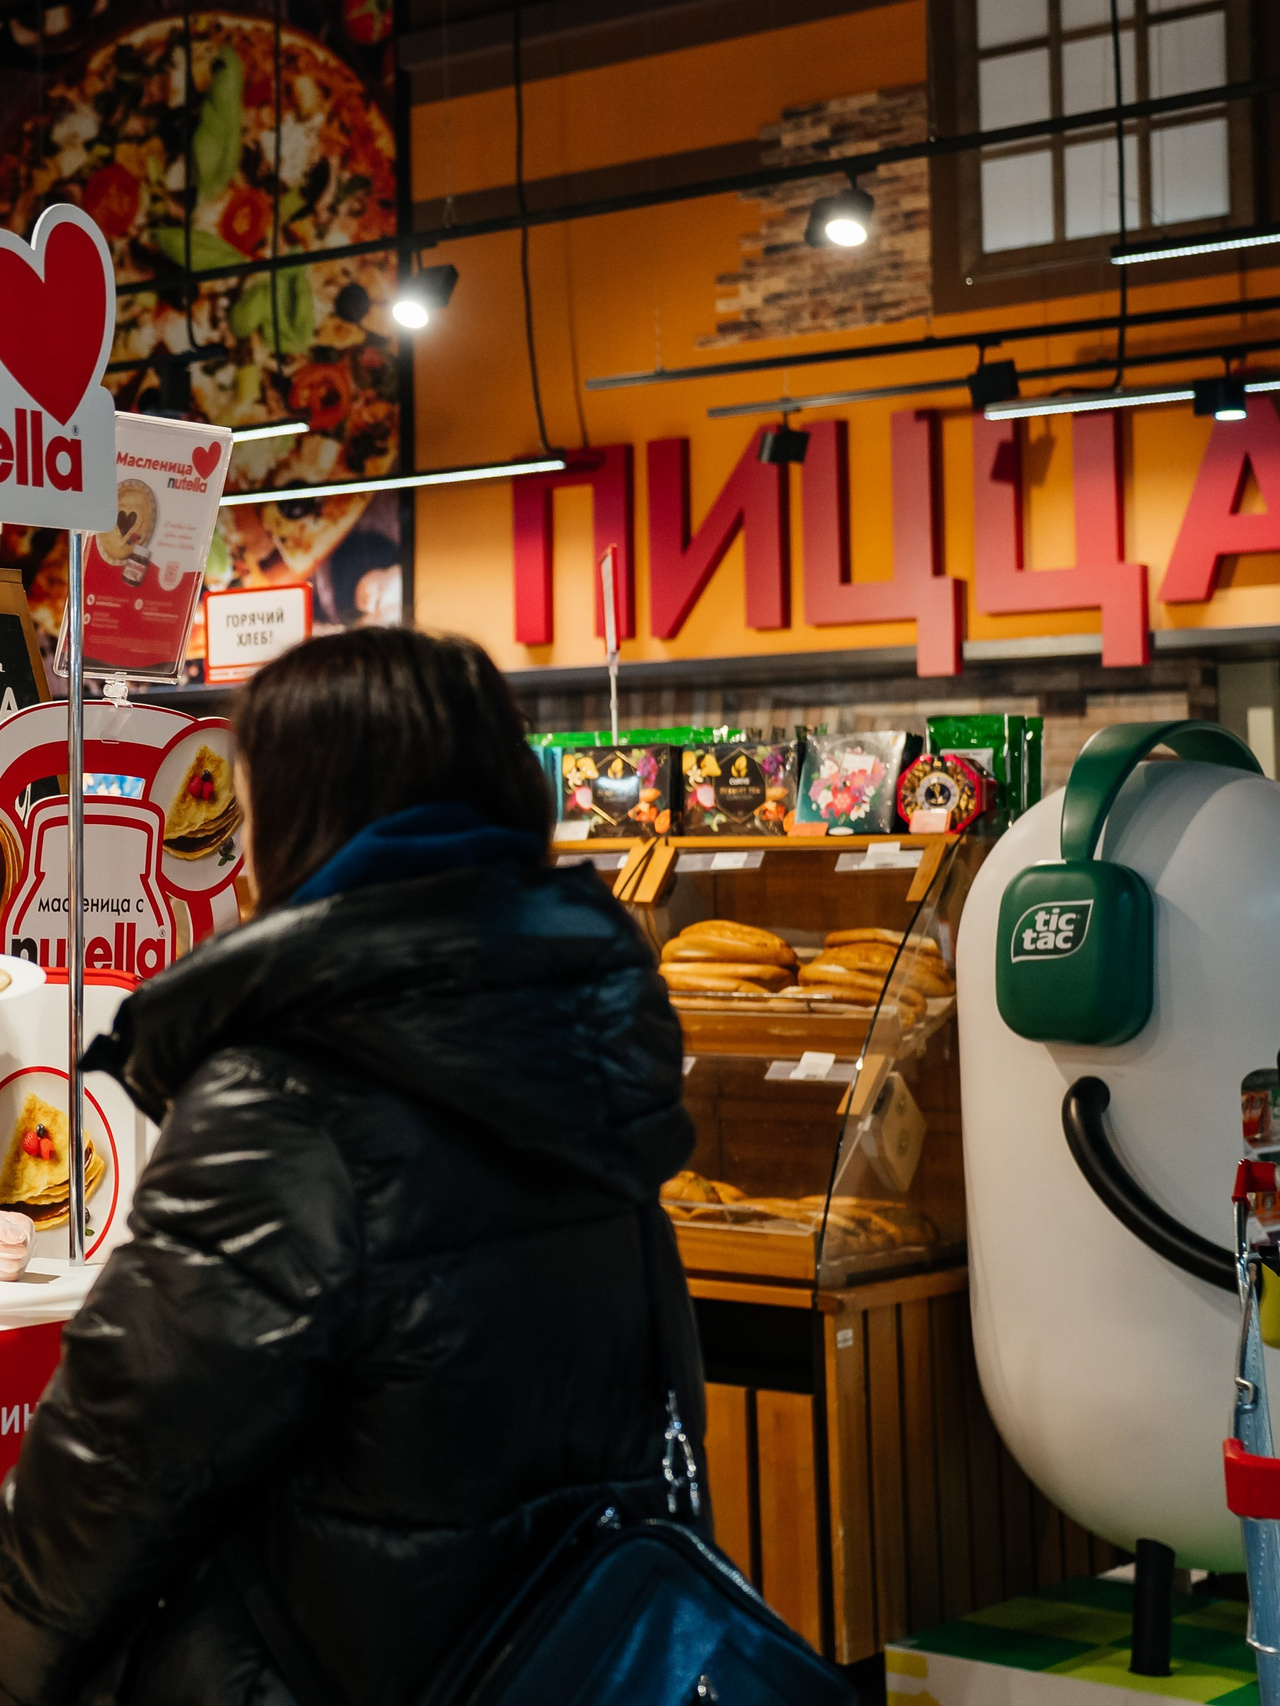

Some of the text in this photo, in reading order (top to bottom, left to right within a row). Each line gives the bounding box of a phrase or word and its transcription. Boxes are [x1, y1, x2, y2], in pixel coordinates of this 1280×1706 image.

[116, 451, 193, 476] Масленица
[167, 477, 208, 493] nutella
[512, 392, 1280, 677] ПИЦЦА
[226, 609, 284, 629] ГОРЯЧИЙ
[236, 631, 274, 646] ХЛЕБ!
[38, 897, 144, 915] масеница с
[1034, 907, 1075, 933] tic
[1022, 927, 1073, 950] tac
[12, 922, 166, 979] nuella
